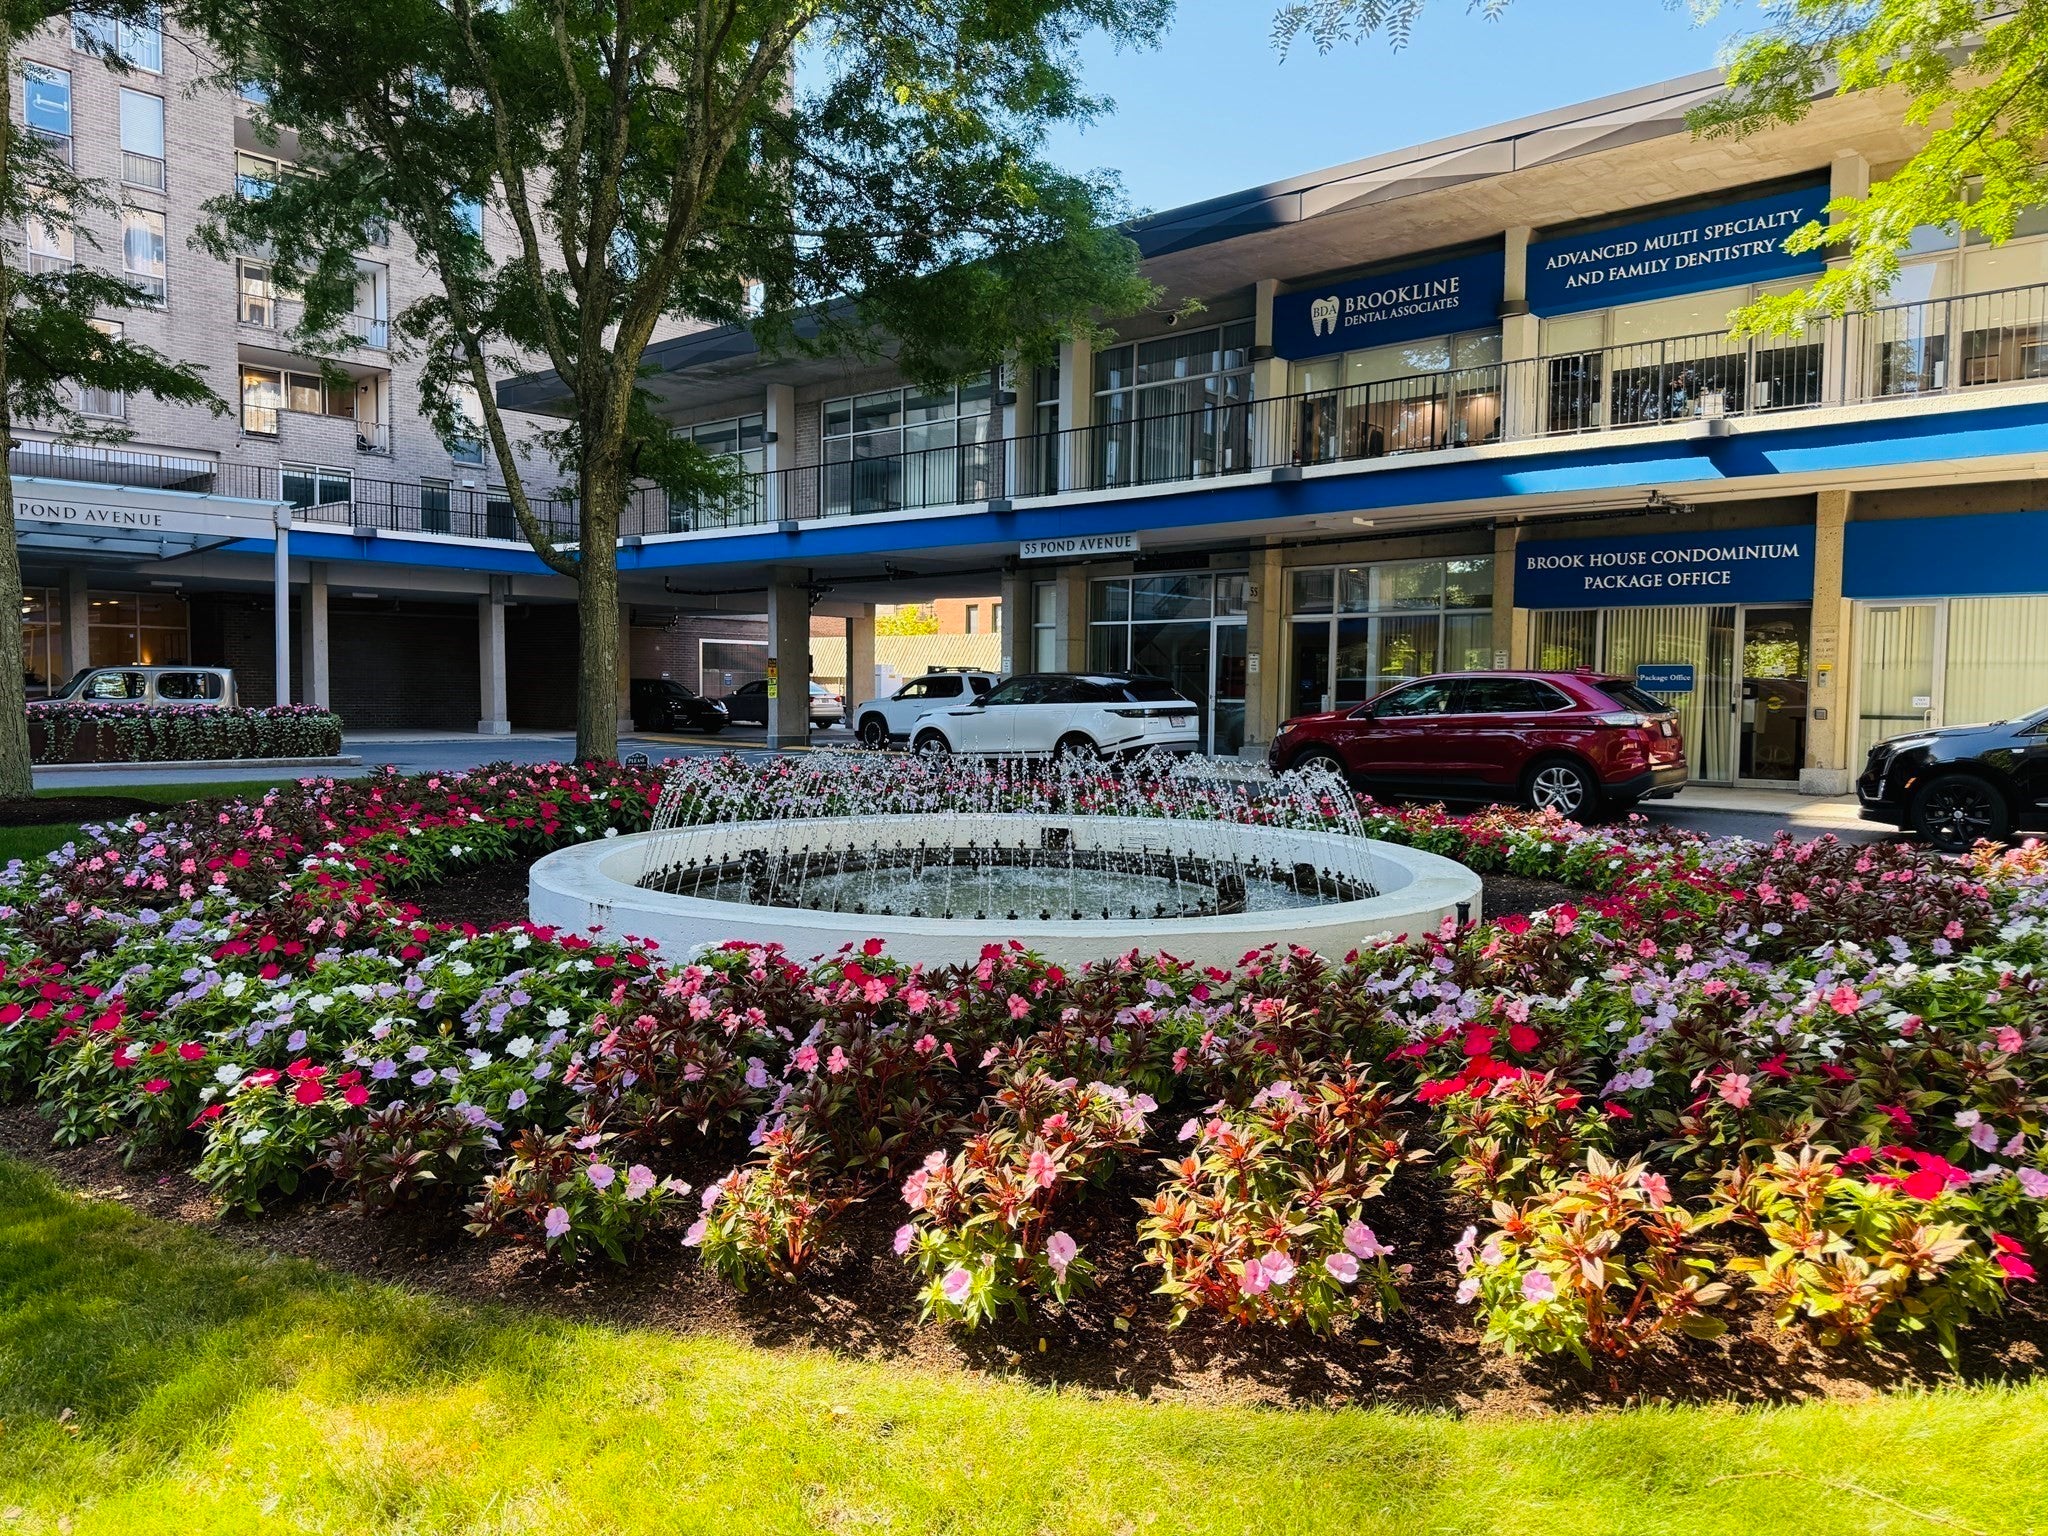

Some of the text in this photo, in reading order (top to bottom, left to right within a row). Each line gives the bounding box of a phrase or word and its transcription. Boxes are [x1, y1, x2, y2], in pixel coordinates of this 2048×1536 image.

[1545, 208, 1803, 270] ADVANCED MULTI SPECIALTY
[1565, 238, 1777, 289] AND FAMILY DENTISTRY
[1344, 276, 1460, 313] BROOKLINE
[1313, 304, 1337, 319] BDA
[1344, 296, 1460, 327] DENTAL ASSOCIATES
[20, 503, 162, 526] POND AVENUE
[1024, 535, 1131, 555] 55 POND AVENUE
[1526, 543, 1800, 570] BROOK HOUSE CONDOMINIUM
[1250, 586, 1258, 597] 55
[1584, 570, 1731, 590] PACKAGE OFFICE
[1640, 674, 1668, 682] Package
